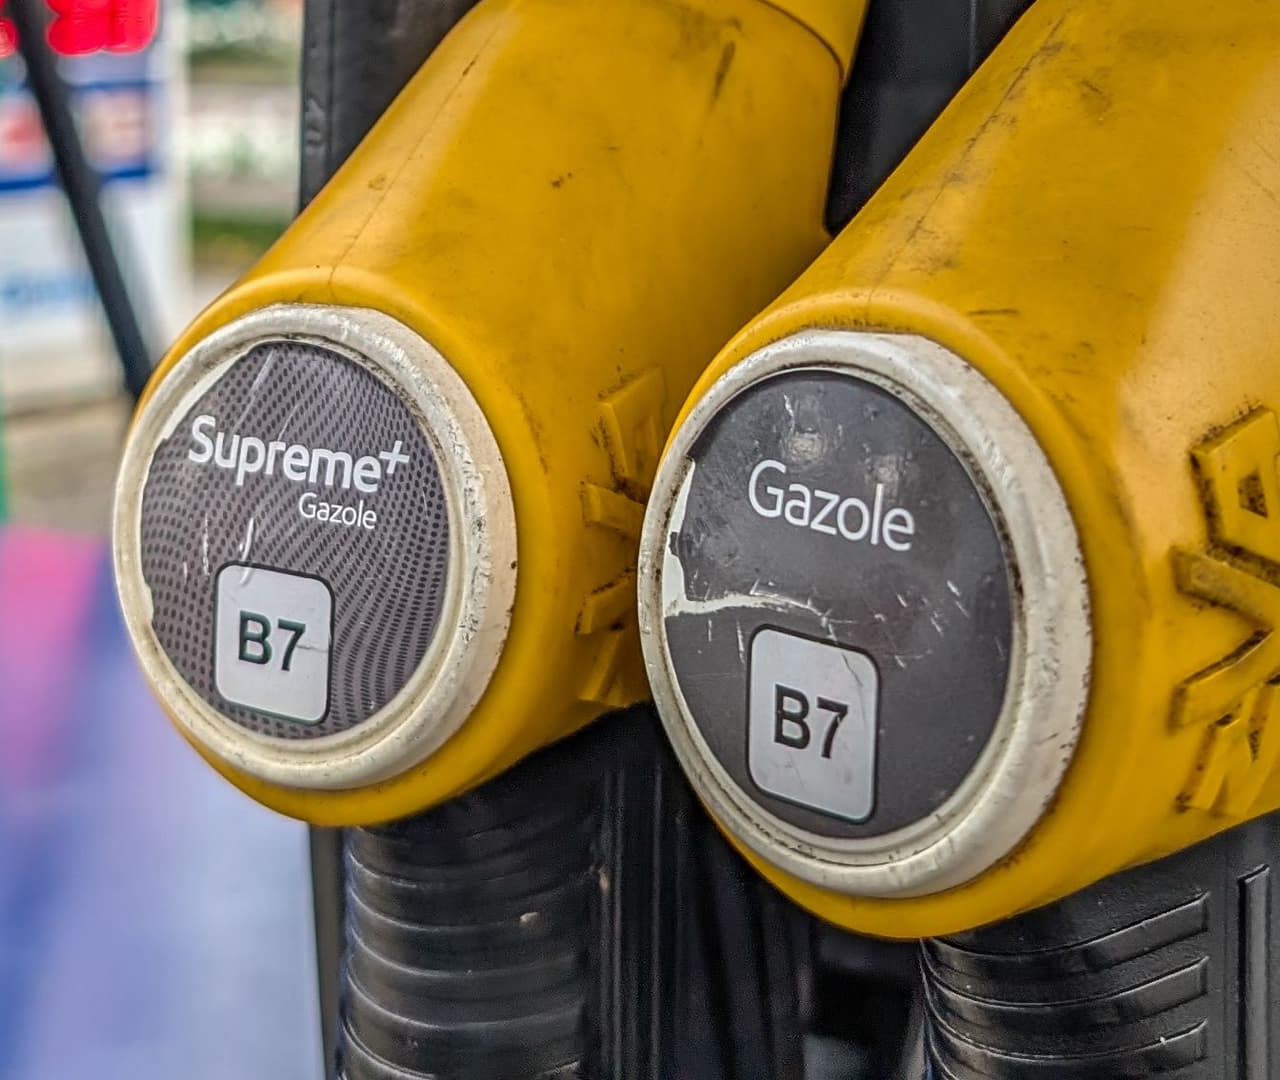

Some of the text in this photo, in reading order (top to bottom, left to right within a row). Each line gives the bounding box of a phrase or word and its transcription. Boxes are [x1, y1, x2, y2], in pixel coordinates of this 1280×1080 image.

[187, 414, 411, 494] Supreme+
[298, 492, 378, 530] Gazole
[748, 459, 916, 552] Gazole
[238, 609, 307, 672] B7
[774, 683, 850, 760] B7
